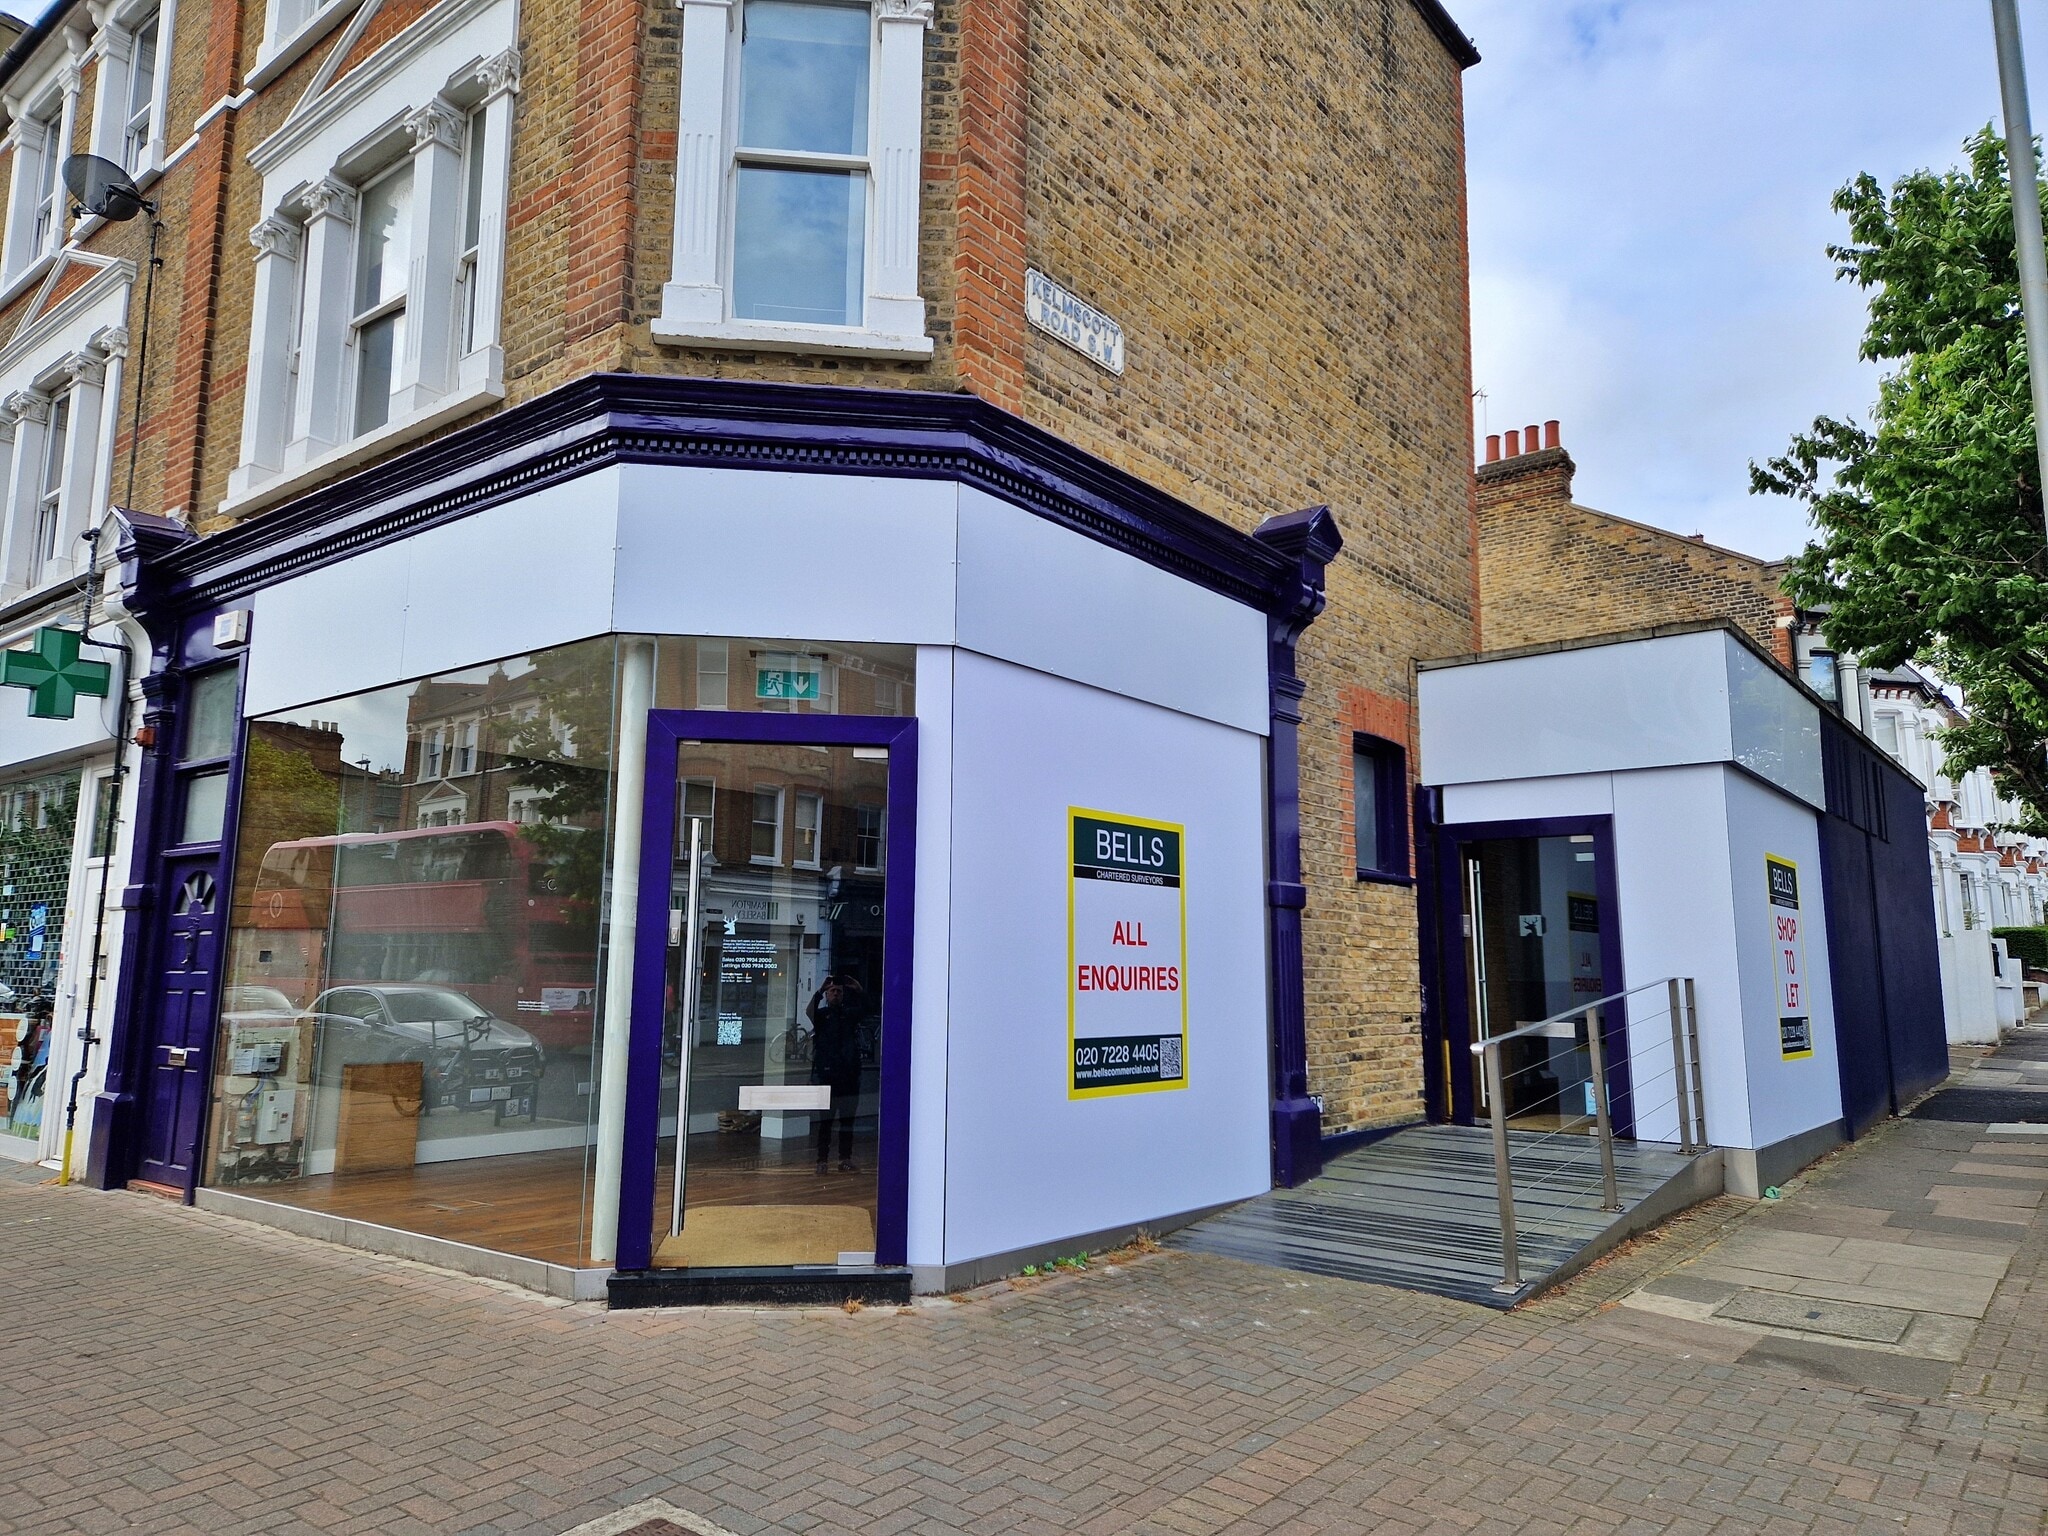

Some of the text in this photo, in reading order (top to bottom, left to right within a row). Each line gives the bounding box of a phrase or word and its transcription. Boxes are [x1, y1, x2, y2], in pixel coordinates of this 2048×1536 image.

[1032, 275, 1118, 347] KELMSCOTT
[1041, 303, 1080, 343] ROAD
[1096, 829, 1164, 867] BELLS
[1096, 870, 1164, 885] CHARTERED SURVEYORS
[1773, 868, 1793, 895] BELLS
[1112, 921, 1148, 947] ALL
[1776, 915, 1797, 942] SHOP
[1784, 949, 1796, 975] TO
[1078, 965, 1179, 992] ENQUIRIES
[1786, 983, 1799, 1008] LET
[1076, 1044, 1159, 1066] 020 7228 4405
[1076, 1064, 1159, 1079] www.bellscommercial.co.uk
